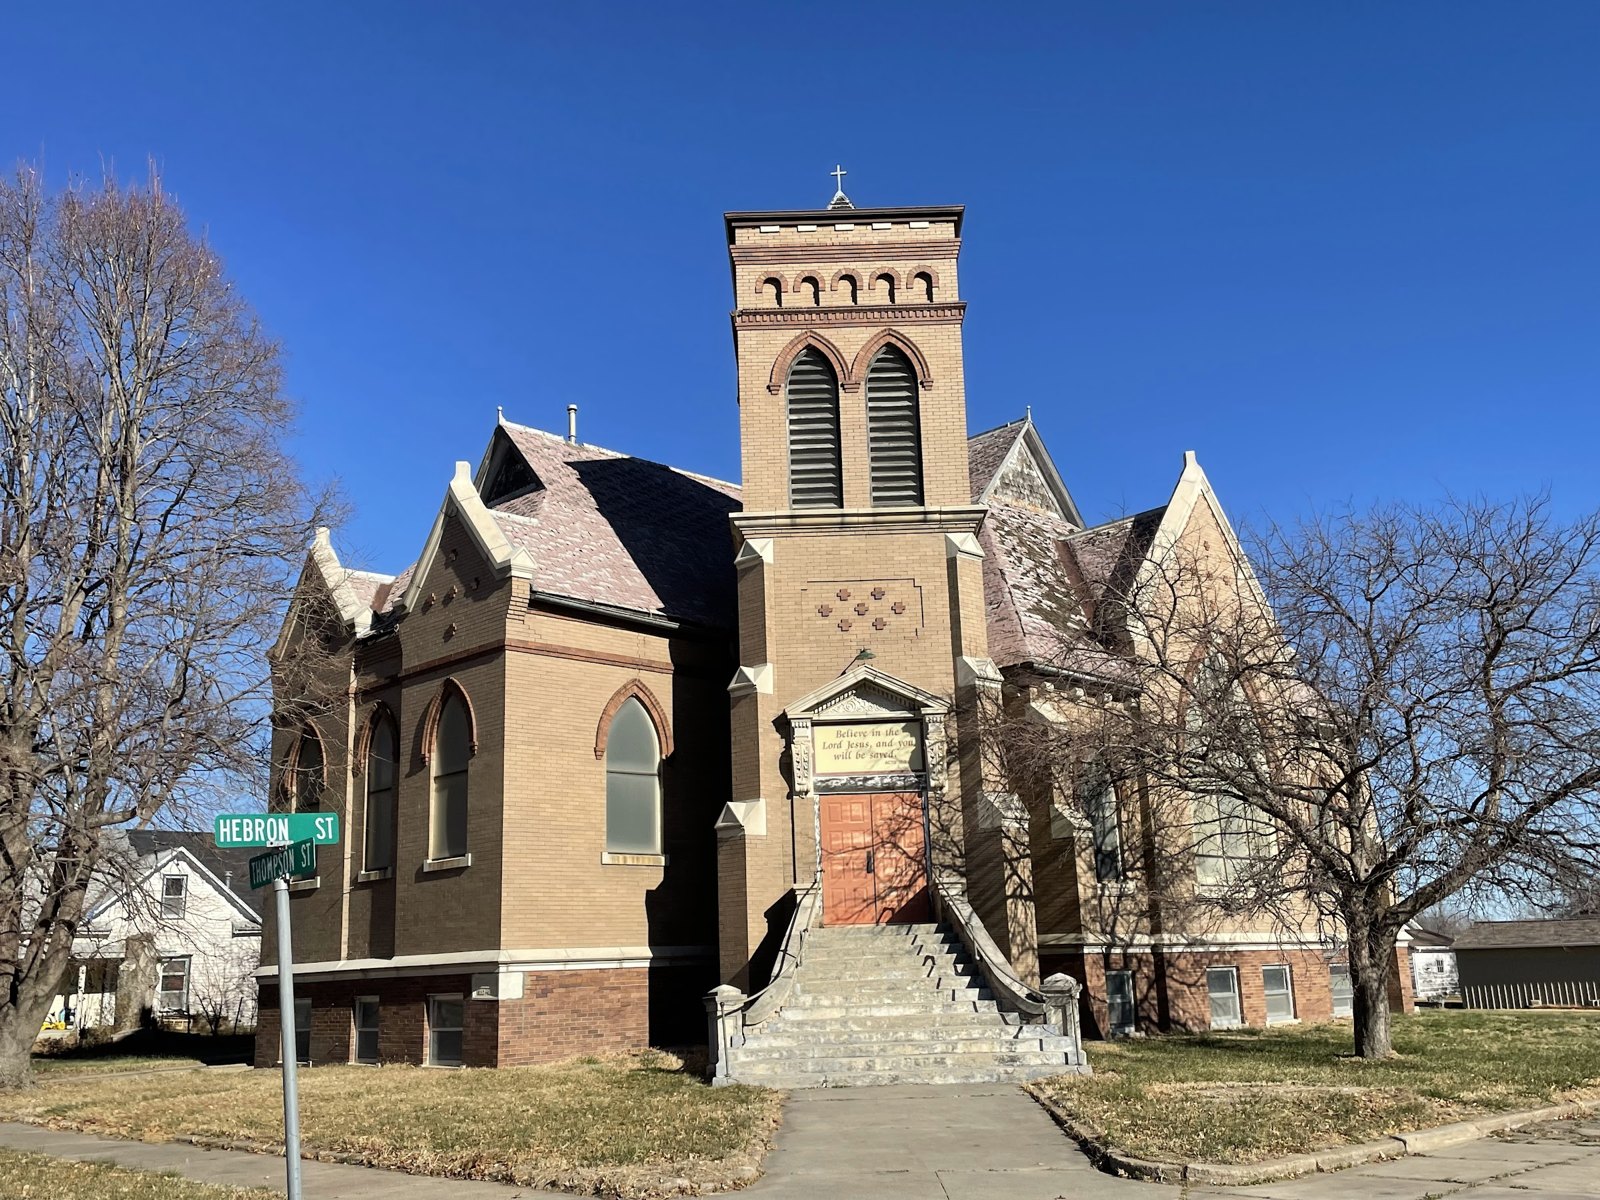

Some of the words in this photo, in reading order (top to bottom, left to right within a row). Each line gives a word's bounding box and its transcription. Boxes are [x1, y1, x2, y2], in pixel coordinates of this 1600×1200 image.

[836, 729, 868, 738] Believe
[872, 727, 881, 737] in
[885, 727, 900, 737] the
[822, 741, 842, 750] Lord
[847, 740, 872, 749] Jesus,
[876, 738, 893, 747] and
[833, 750, 852, 760] will
[855, 751, 865, 760] be
[869, 750, 897, 760] saved.
[220, 818, 289, 842] HEBRON
[315, 817, 334, 839] ST
[251, 849, 294, 884] THOMPSON
[301, 842, 311, 868] ST
